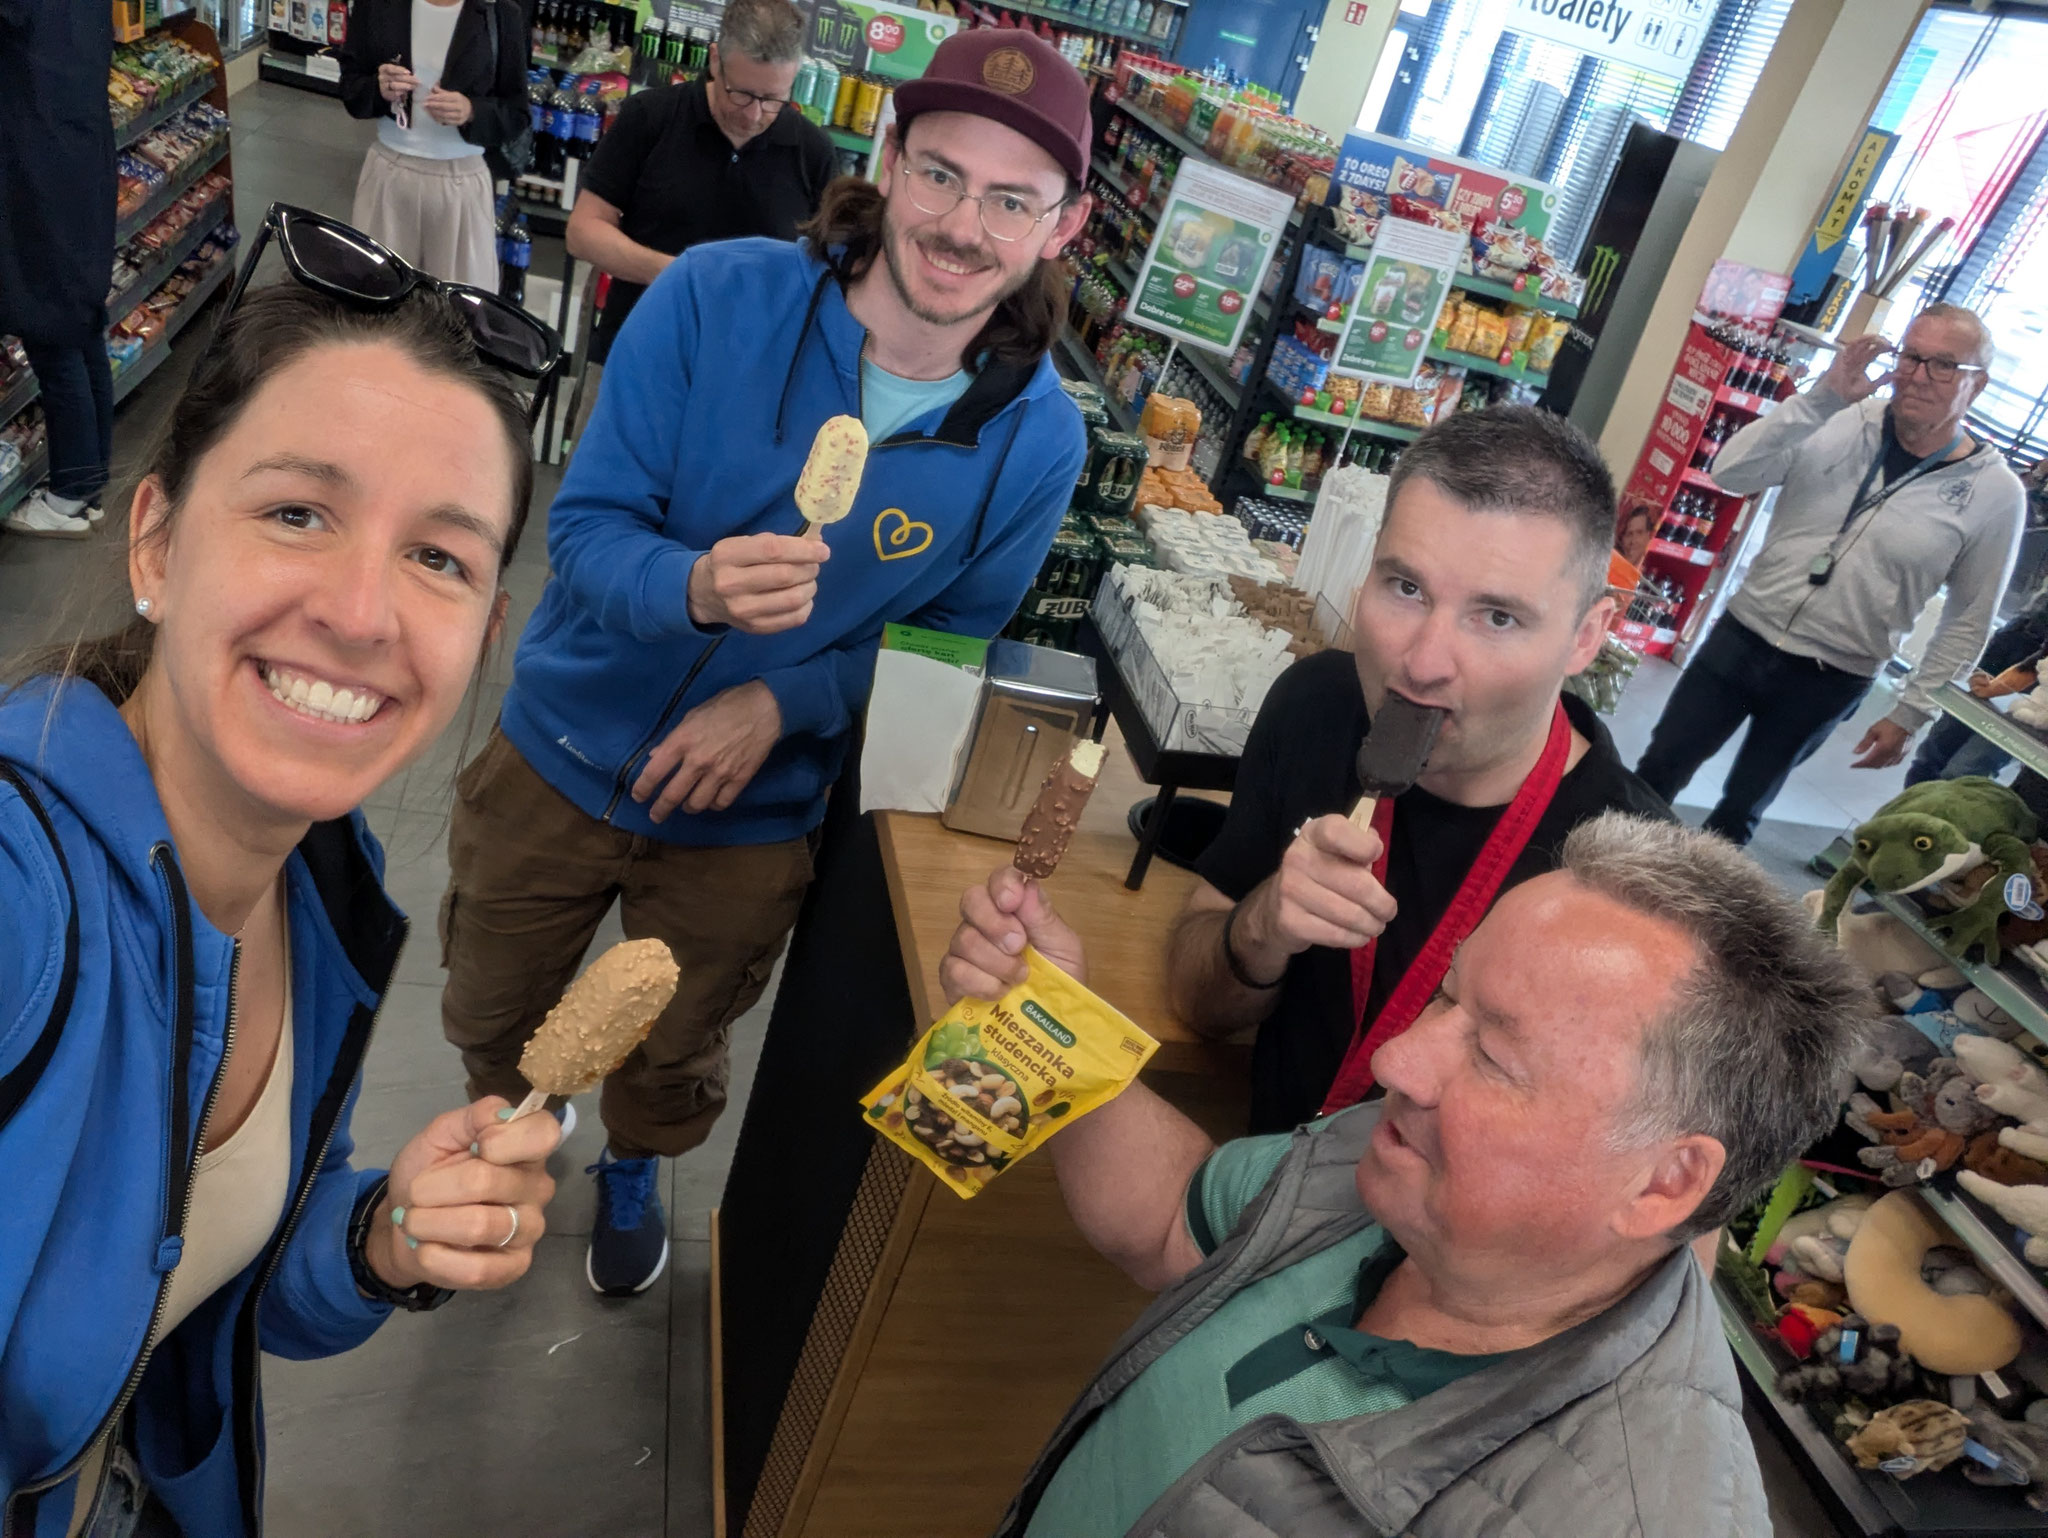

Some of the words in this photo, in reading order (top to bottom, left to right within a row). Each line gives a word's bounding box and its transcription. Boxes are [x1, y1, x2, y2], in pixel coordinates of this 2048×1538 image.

[1343, 156, 1358, 170] TO
[1360, 161, 1390, 178] OREO
[1348, 172, 1387, 189] 7DAYS!
[1831, 141, 1877, 228] ALKOMAT
[1139, 301, 1165, 317] Dobre
[1165, 312, 1185, 324] ceny
[1025, 1003, 1073, 1045] BAKALLAND
[983, 1023, 1057, 1087] studencka
[989, 1003, 1075, 1080] Mieszanka
[990, 1047, 1030, 1082] klasyczna
[960, 1104, 988, 1128] witaminy
[960, 1114, 988, 1136] manganu
